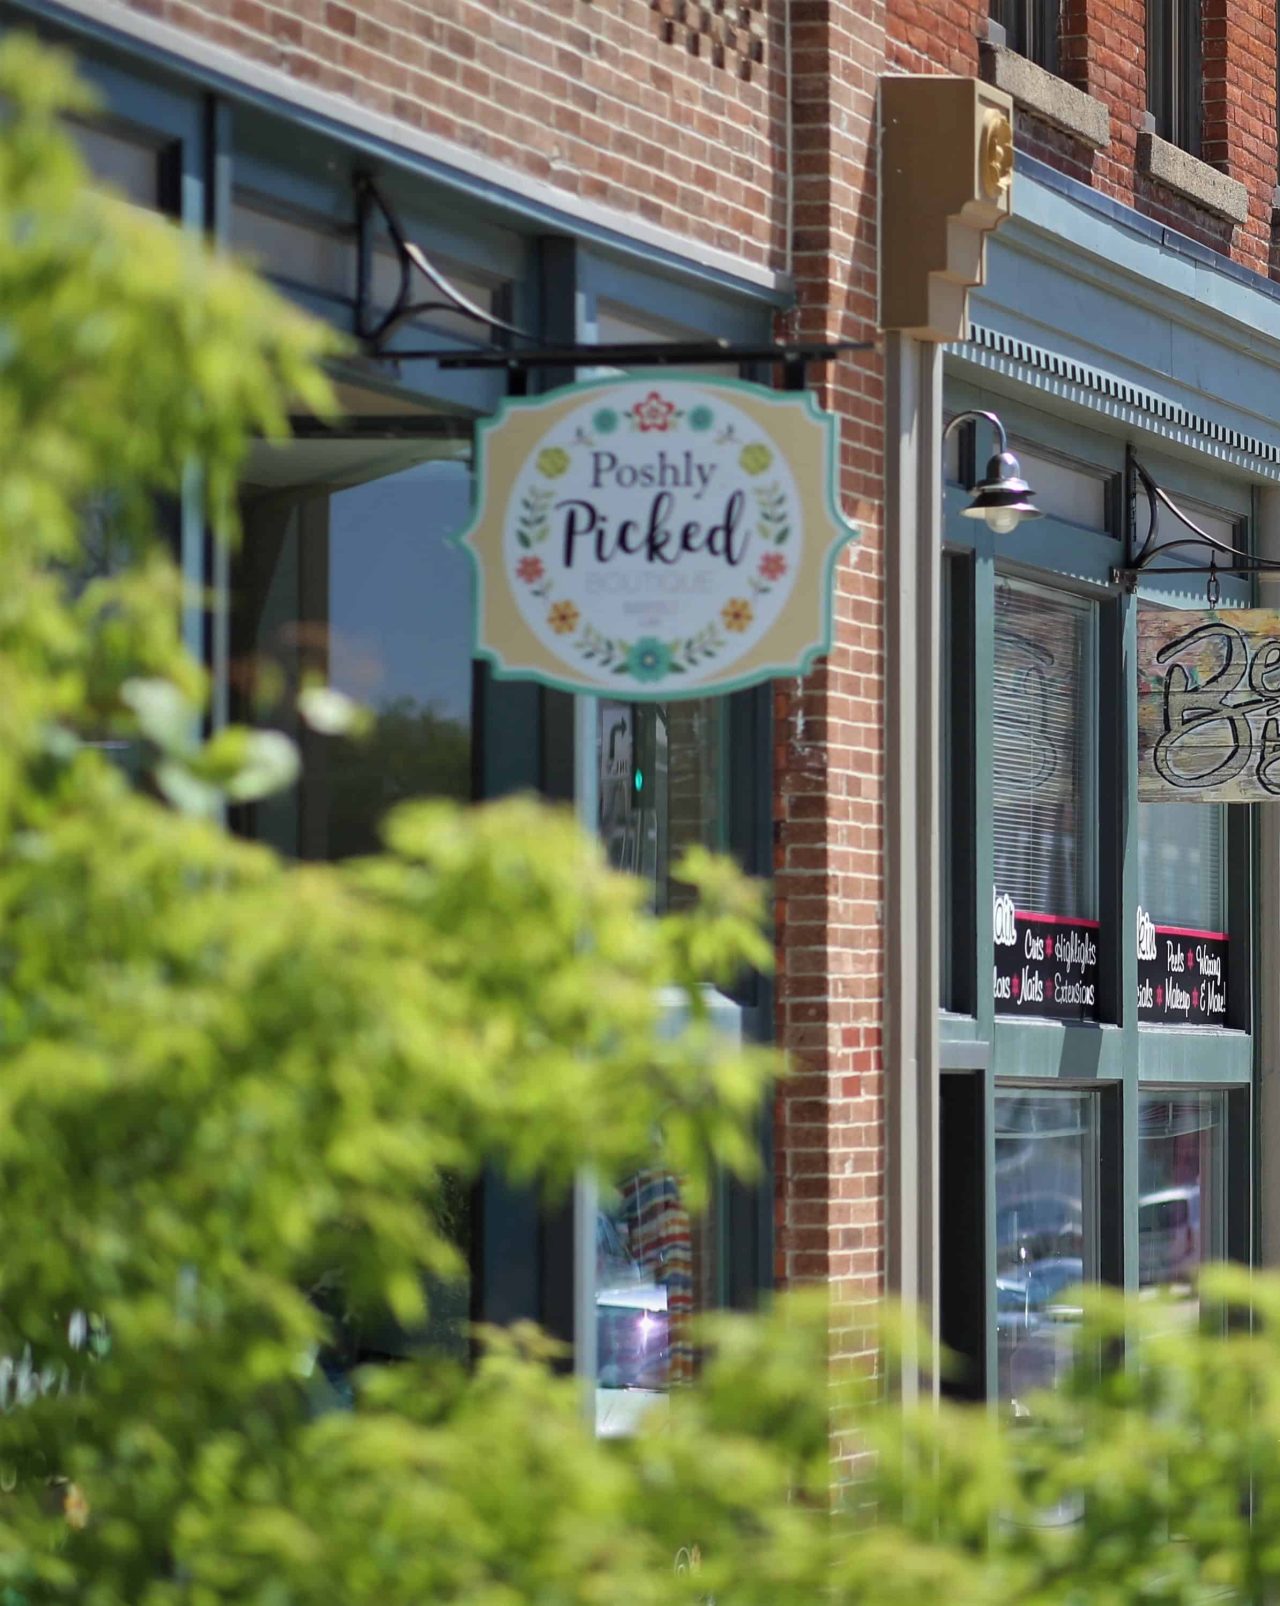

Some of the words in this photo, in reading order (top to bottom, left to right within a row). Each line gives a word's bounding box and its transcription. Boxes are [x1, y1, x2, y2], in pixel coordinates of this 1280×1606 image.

[591, 451, 717, 499] Poshly
[554, 488, 752, 568] Picked
[1025, 929, 1044, 961] Cuts
[1055, 930, 1096, 974] Highlights
[1166, 940, 1184, 972] Peels
[1196, 944, 1221, 986] Waxing
[1017, 965, 1043, 1005] Nails
[1055, 972, 1095, 1006] Extensions
[1164, 976, 1190, 1018] Makeup
[1207, 980, 1226, 1016] More!
